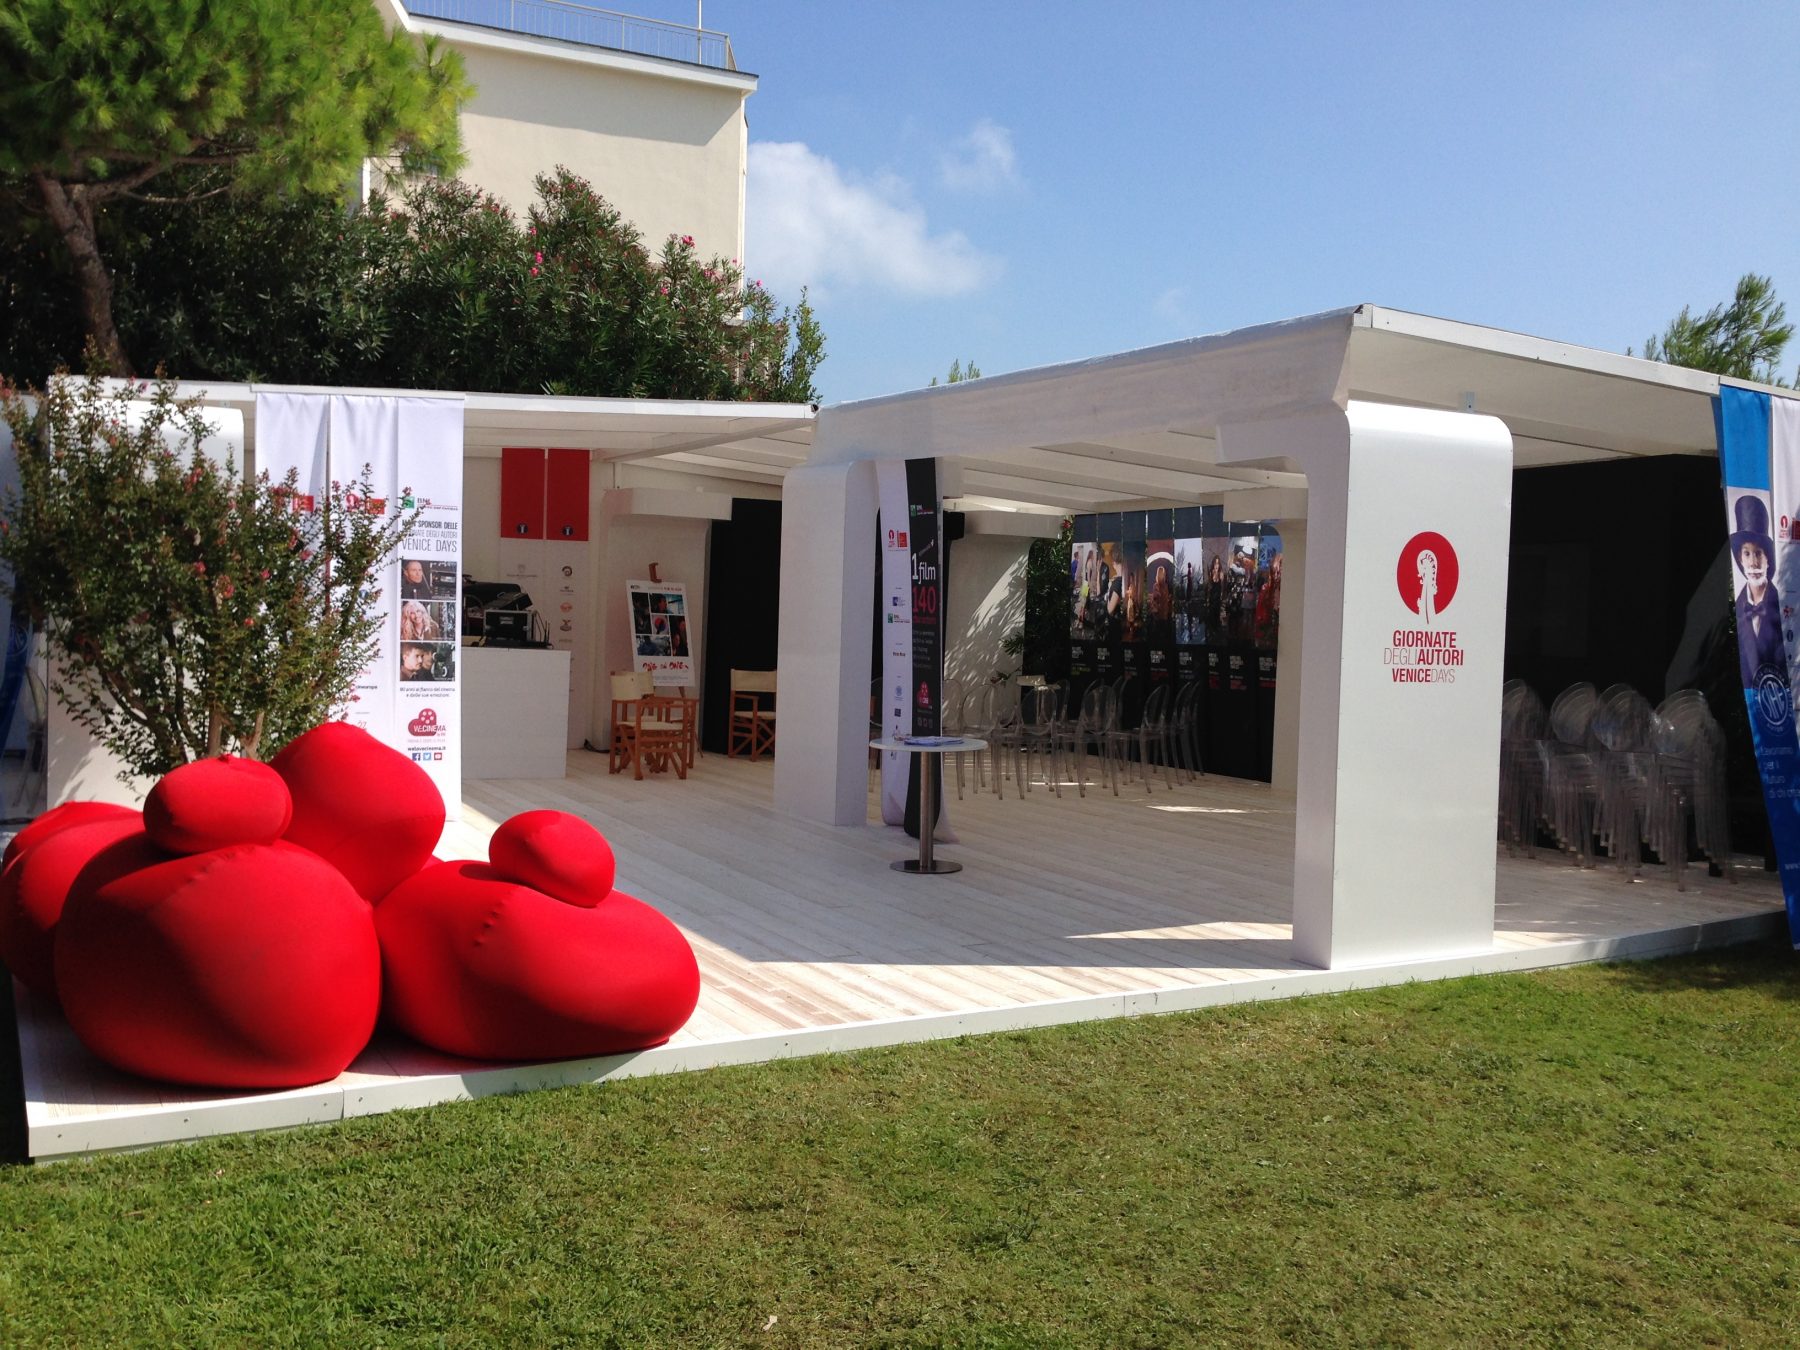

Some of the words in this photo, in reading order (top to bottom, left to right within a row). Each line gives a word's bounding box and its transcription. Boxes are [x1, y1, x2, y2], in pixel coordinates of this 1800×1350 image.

[417, 520, 442, 528] SPONSOR
[443, 521, 458, 530] DELLE
[402, 538, 431, 551] VENICE
[435, 539, 458, 553] DAYS
[912, 586, 936, 614] 140
[1393, 630, 1457, 648] GIORNATE
